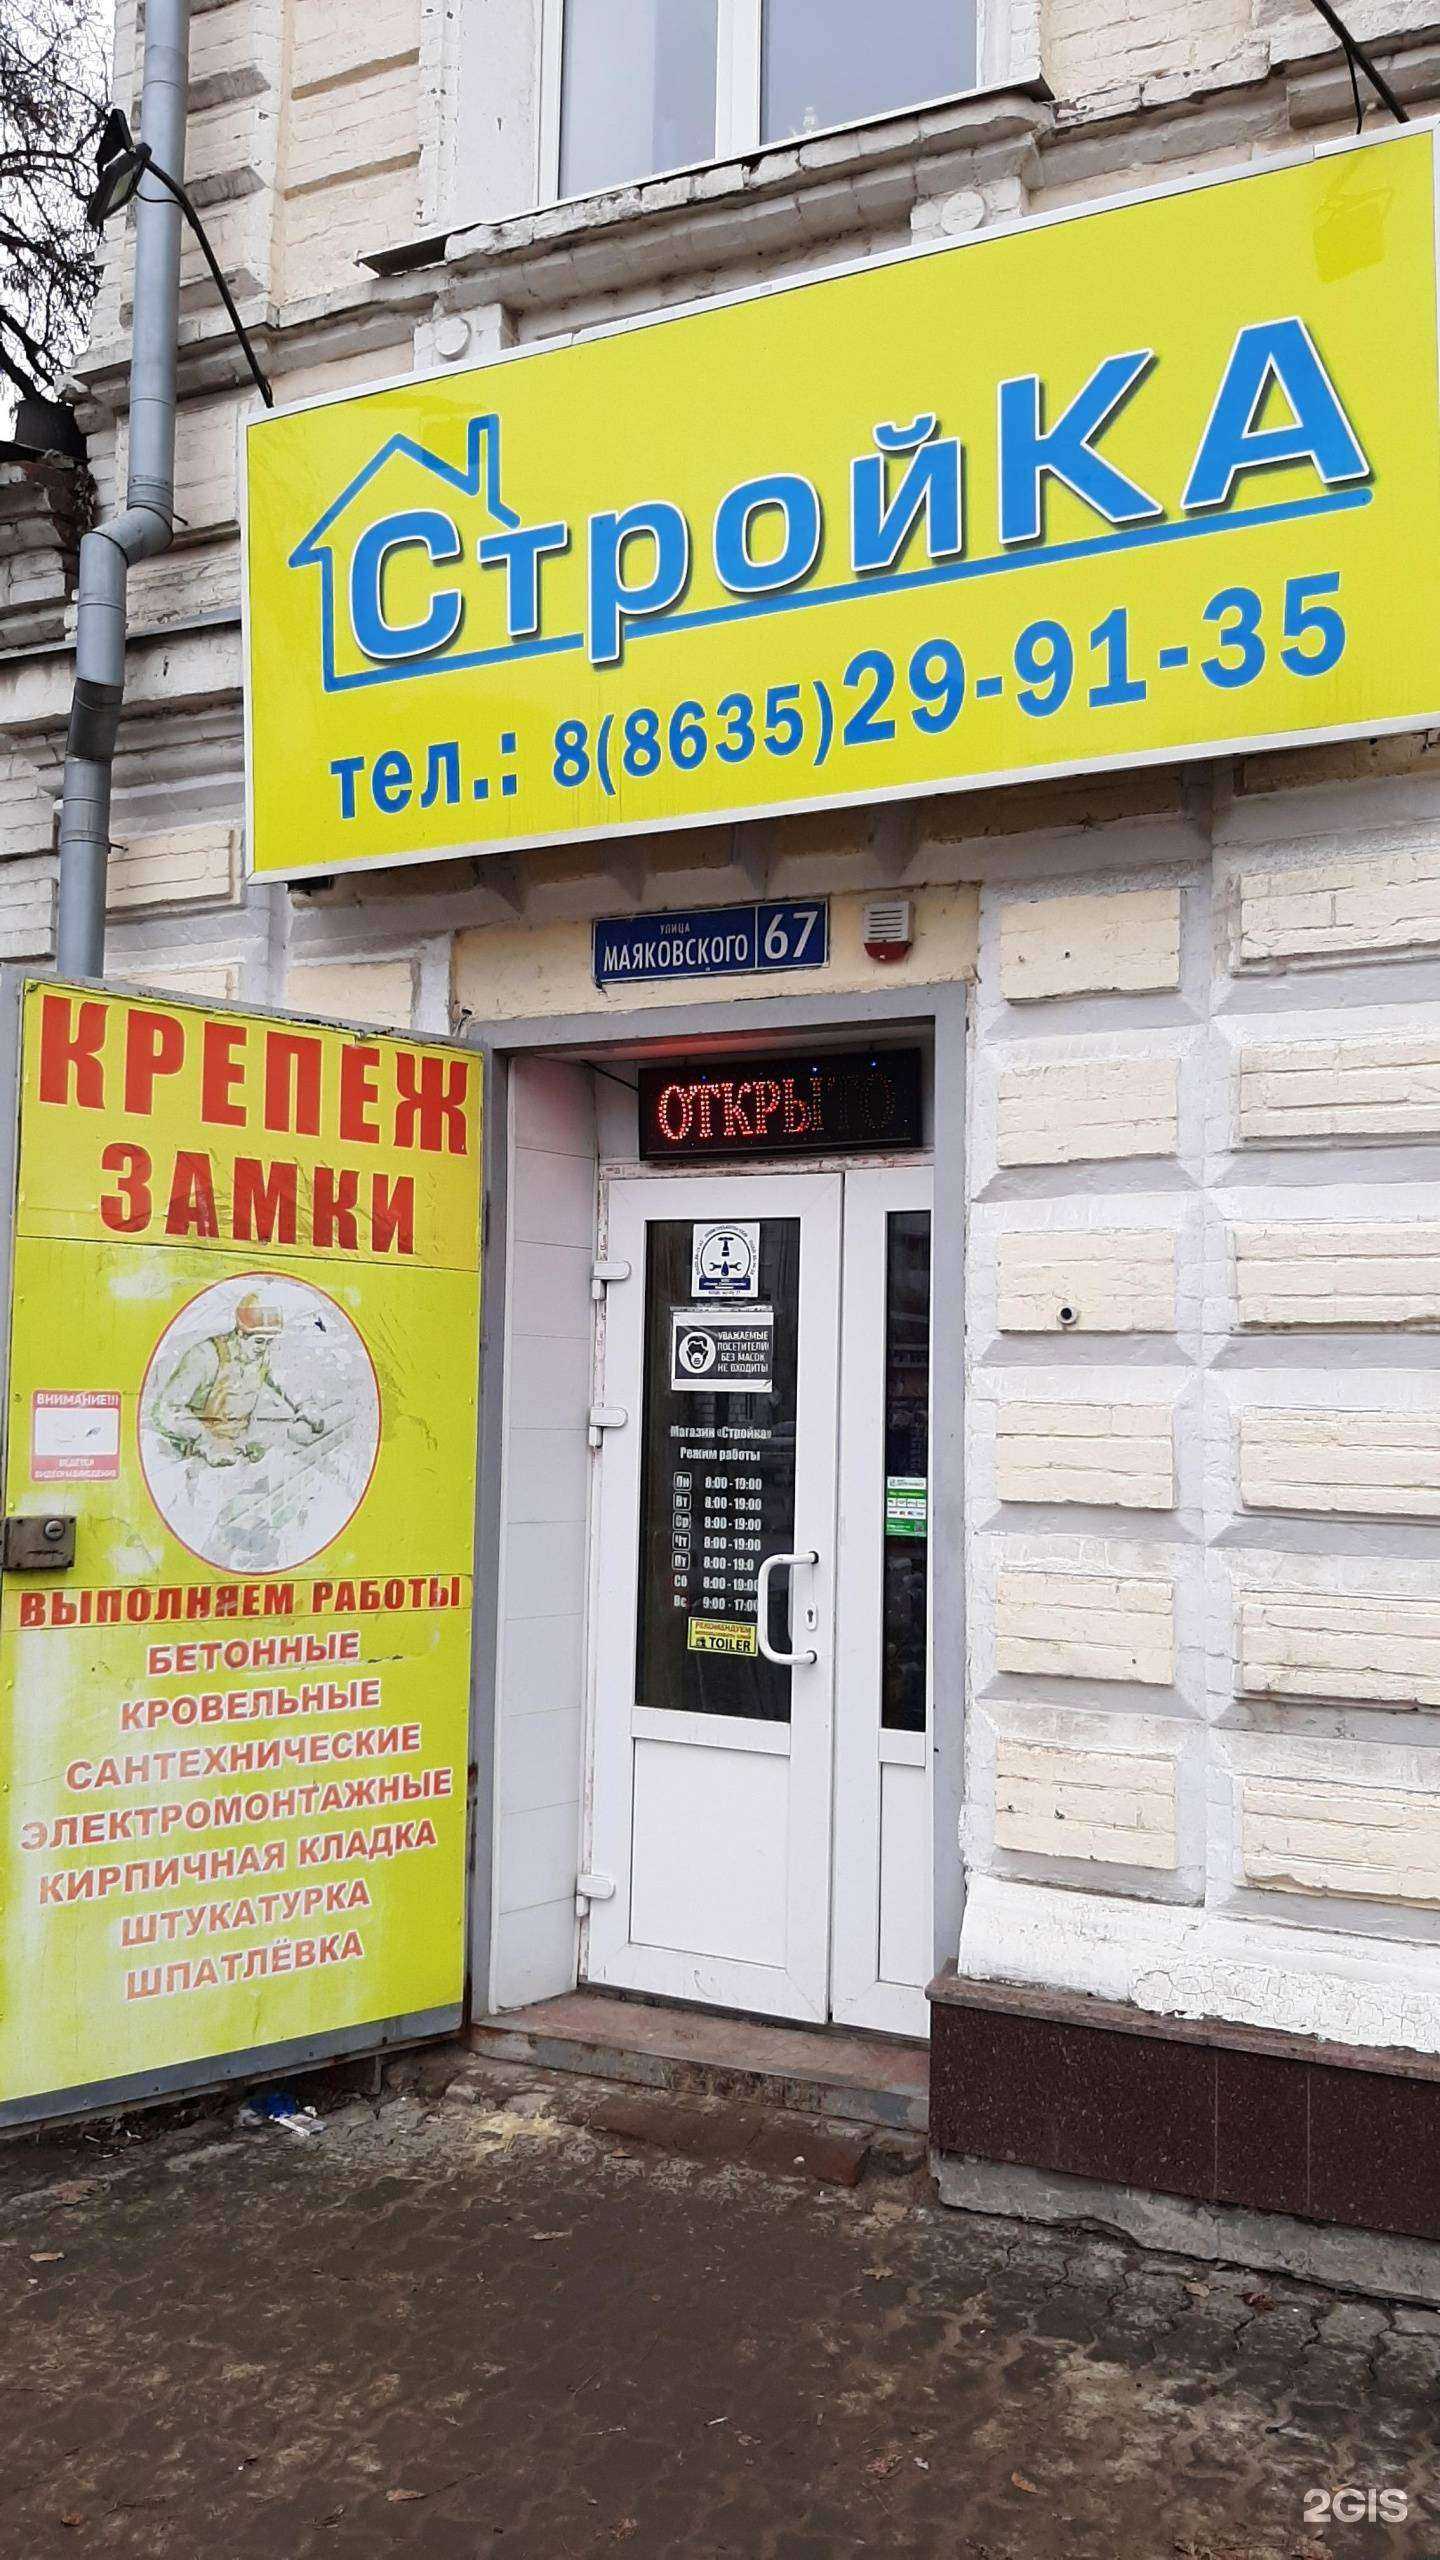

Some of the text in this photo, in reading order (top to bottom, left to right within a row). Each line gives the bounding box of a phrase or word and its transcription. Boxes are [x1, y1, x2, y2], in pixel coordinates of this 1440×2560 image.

[349, 315, 1373, 665] СтройКА
[330, 570, 1348, 820] тел.: 8(8635)29-91-35
[603, 910, 819, 972] МАЯКОВСКОГО 67
[659, 922, 691, 935] УЛИЦА
[39, 994, 469, 1155] КРЕПЕЖ
[100, 1142, 415, 1255] ЗАМКИ
[721, 1352, 736, 1362] БЕЗ
[670, 1425, 715, 1438] Магазин
[680, 1446, 760, 1461] Режим работы
[704, 1496, 727, 1509] 8:00
[705, 1476, 728, 1489] 8:00
[703, 1536, 727, 1549] 8:00
[704, 1516, 727, 1529] 8:00
[702, 1576, 726, 1589] 8:00
[703, 1556, 726, 1569] 8:00
[19, 1576, 461, 1627] ВЫПОЛНЯЕМ РАБОТЫ
[702, 1596, 726, 1610] 9:00
[147, 1631, 360, 1676] БЕТОННЫЕ
[709, 1636, 751, 1652] TOILER
[120, 1679, 381, 1731] КРОВЕЛЬНЫЕ
[65, 1723, 422, 1791] САНТЕХНИЧЕСКИЕ
[20, 1768, 453, 1852] ЭЛЕКТРОМОНТАЖНЫЕ
[40, 1819, 437, 1905] КИРПИЧНАЯ КЛАДКА
[120, 1879, 370, 1948] ШТУКАТУРКА
[126, 1930, 365, 2000] ШПАТЛЁВКА
